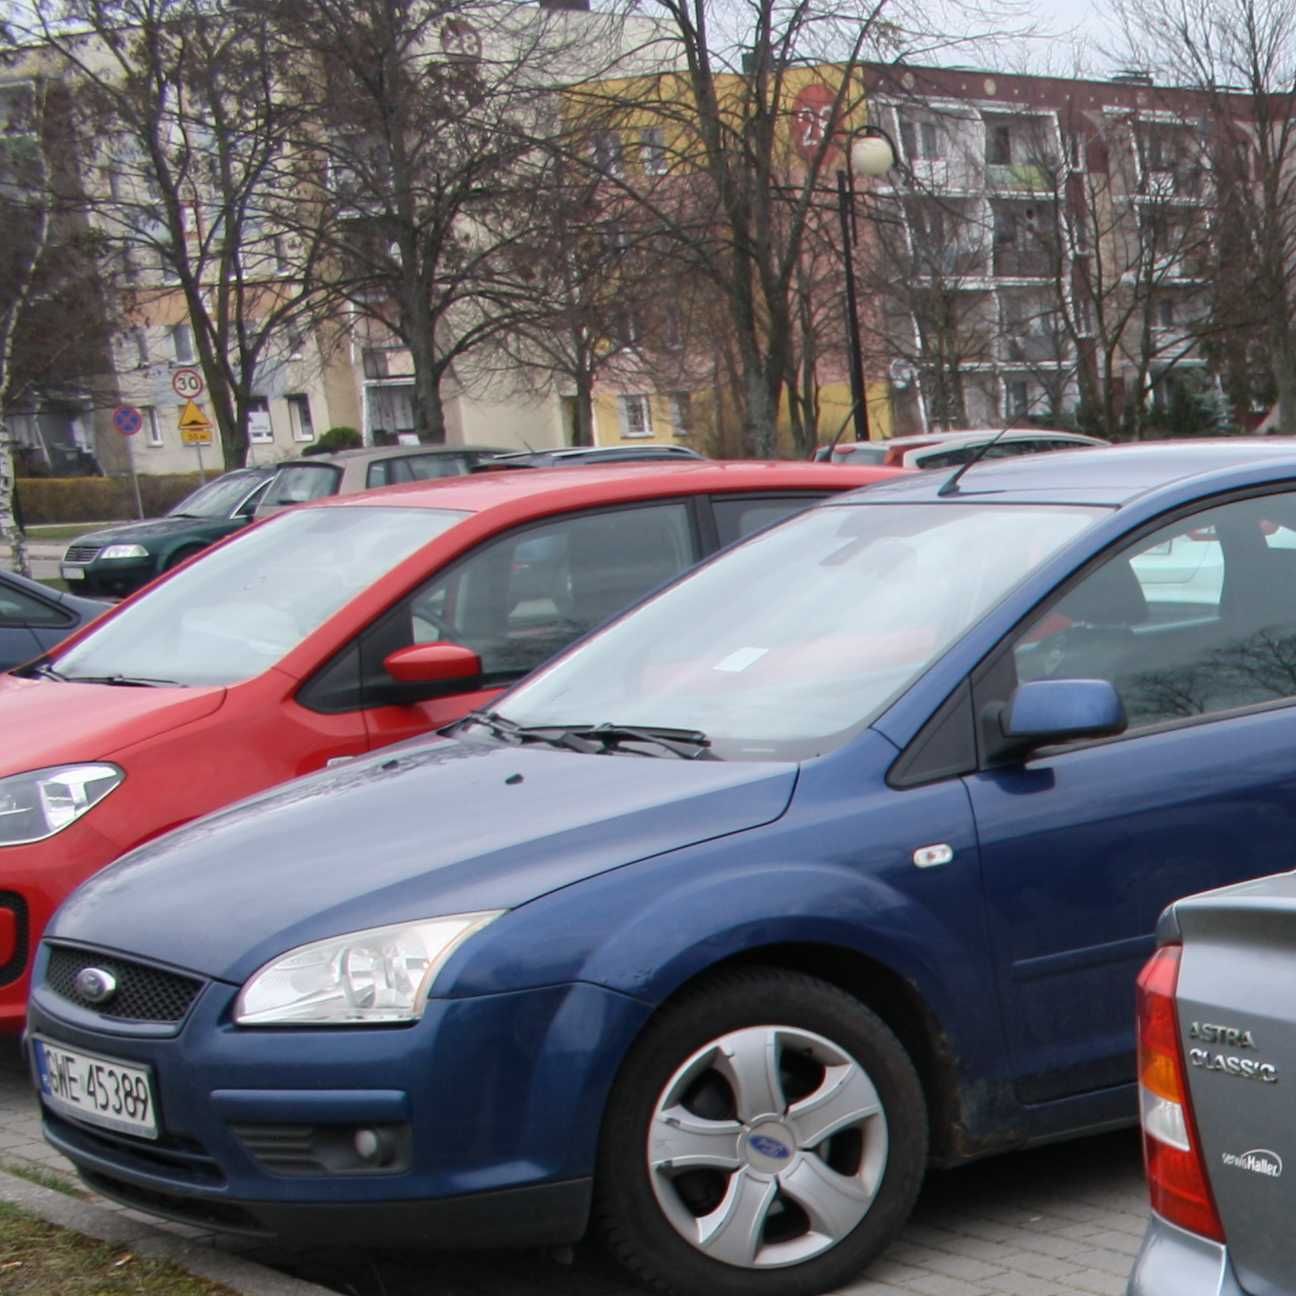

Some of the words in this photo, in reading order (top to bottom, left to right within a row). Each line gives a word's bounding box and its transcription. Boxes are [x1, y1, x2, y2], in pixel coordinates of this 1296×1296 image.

[178, 376, 199, 391] 30
[1190, 1021, 1257, 1049] ASTRA
[1188, 1048, 1278, 1083] CLASSIC
[46, 1049, 82, 1103] GWE
[86, 1063, 149, 1121] 45389
